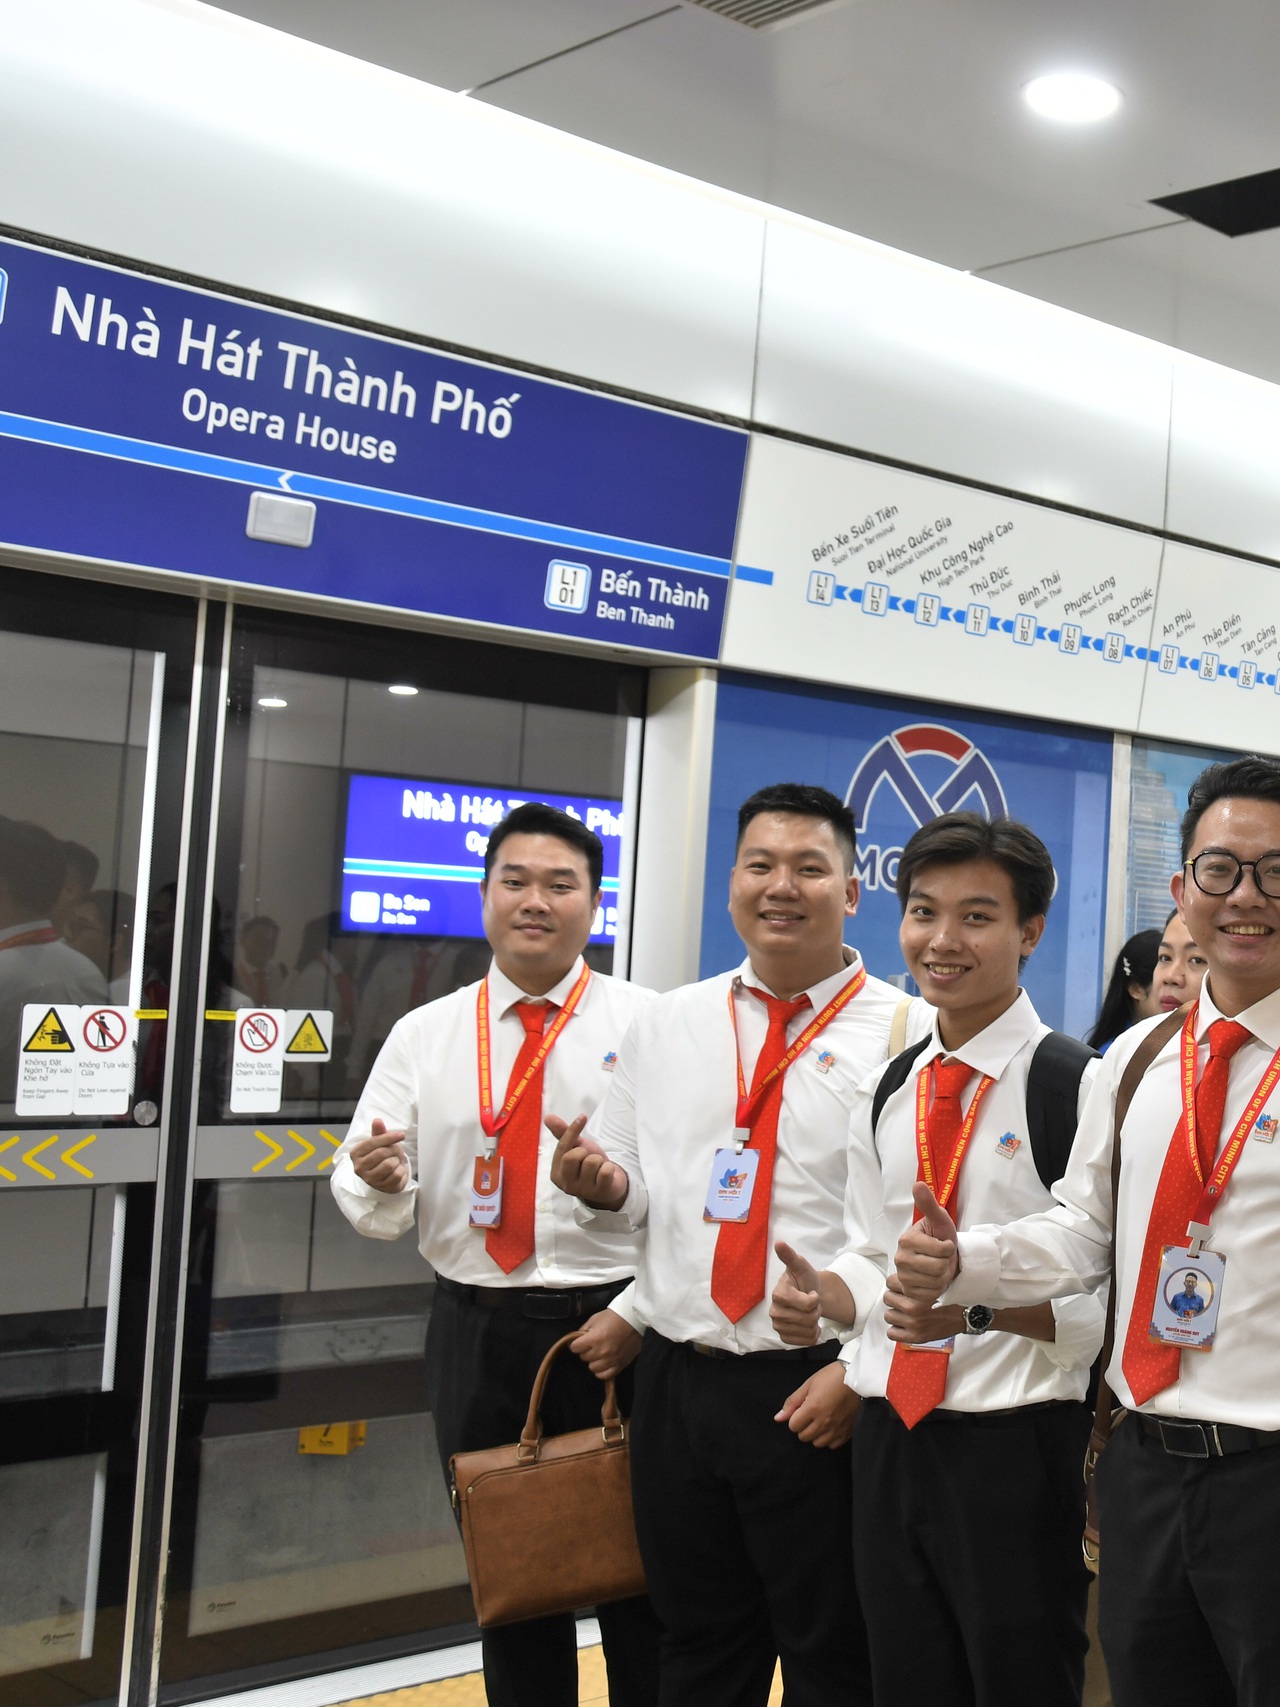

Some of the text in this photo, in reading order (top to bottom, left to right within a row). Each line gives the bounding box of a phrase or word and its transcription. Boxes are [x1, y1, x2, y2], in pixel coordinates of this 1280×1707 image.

[51, 286, 521, 439] Nhà Hát Thành Phố
[183, 388, 397, 464] Opera House
[934, 516, 952, 533] Gia
[835, 534, 850, 549] Xe
[920, 566, 942, 584] Khu
[995, 521, 1014, 537] Cao
[561, 568, 577, 586] L1
[816, 575, 828, 588] L1
[600, 568, 710, 611] Bến Thành
[870, 586, 882, 599] L1
[1092, 575, 1117, 595] Long
[559, 587, 575, 605] 01
[815, 589, 826, 601] 14
[870, 599, 880, 612] 13
[923, 597, 934, 610] L1
[596, 600, 675, 630] Ben Thanh
[922, 610, 932, 623] 12
[973, 608, 984, 620] L1
[1021, 618, 1031, 629] L1
[1066, 627, 1076, 639] L1
[1110, 636, 1120, 647] L1
[1166, 648, 1175, 659] L1
[402, 789, 456, 822] Nhà
[1258, 1070, 1278, 1098] UNION
[1252, 1098, 1262, 1110] OF
[1244, 1109, 1256, 1122] HO
[1236, 1124, 1248, 1140] CHI
[1224, 1140, 1241, 1165] MINH
[1214, 1164, 1229, 1186] CITY
